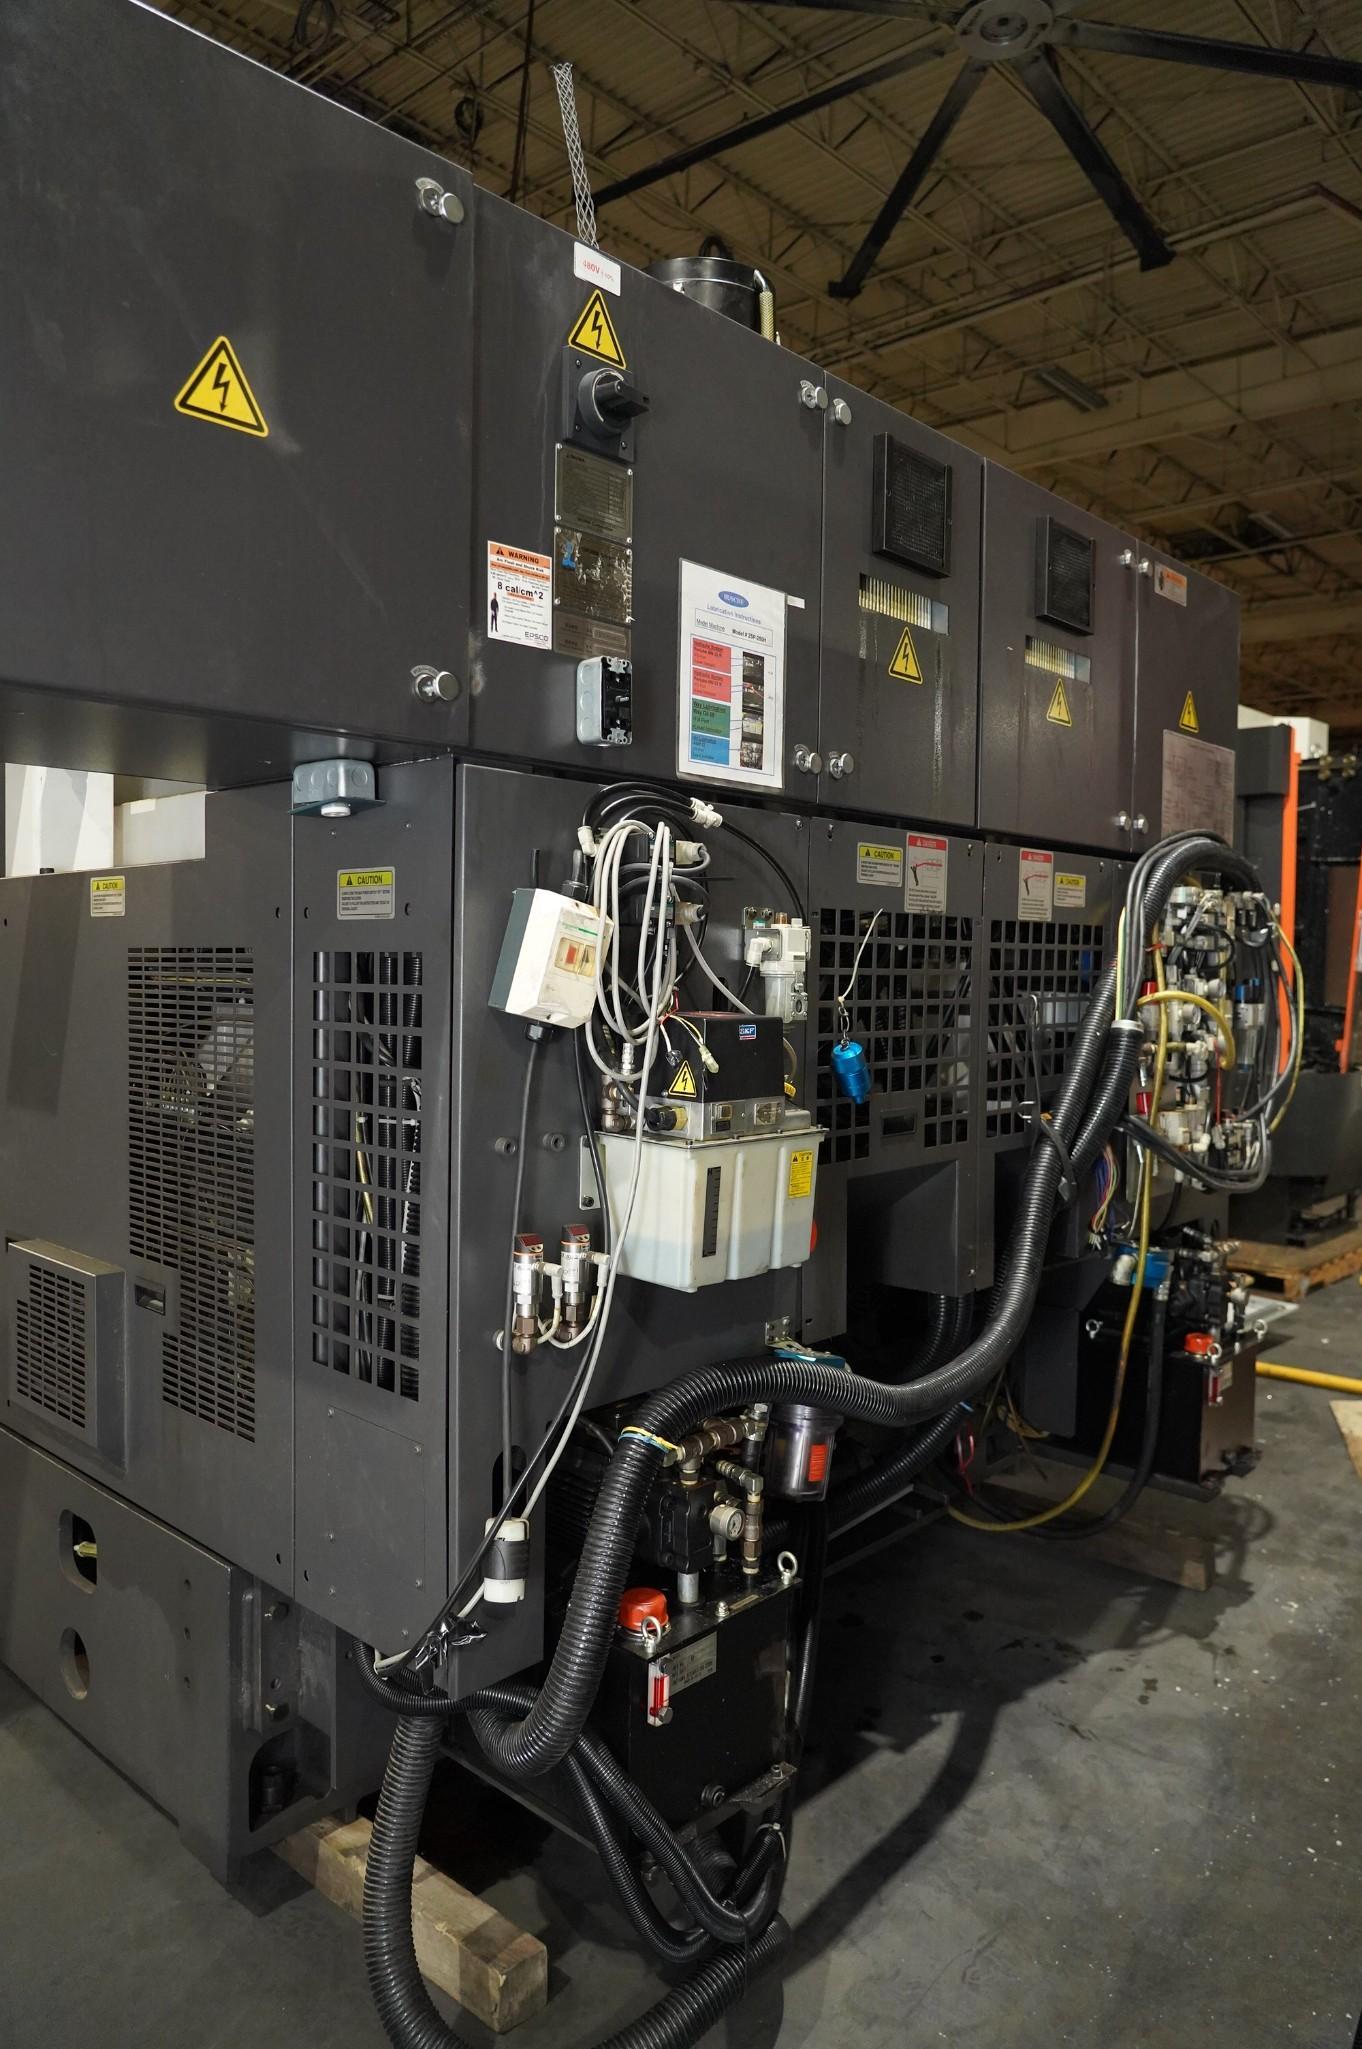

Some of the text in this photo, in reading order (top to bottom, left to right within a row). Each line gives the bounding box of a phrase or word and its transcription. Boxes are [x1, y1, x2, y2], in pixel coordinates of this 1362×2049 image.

[583, 259, 600, 274] 480V
[508, 551, 539, 564] WARNING
[497, 581, 503, 590] 8
[873, 850, 895, 860] CAUTION
[357, 875, 383, 885] CAUTION
[739, 1027, 755, 1035] SKF
